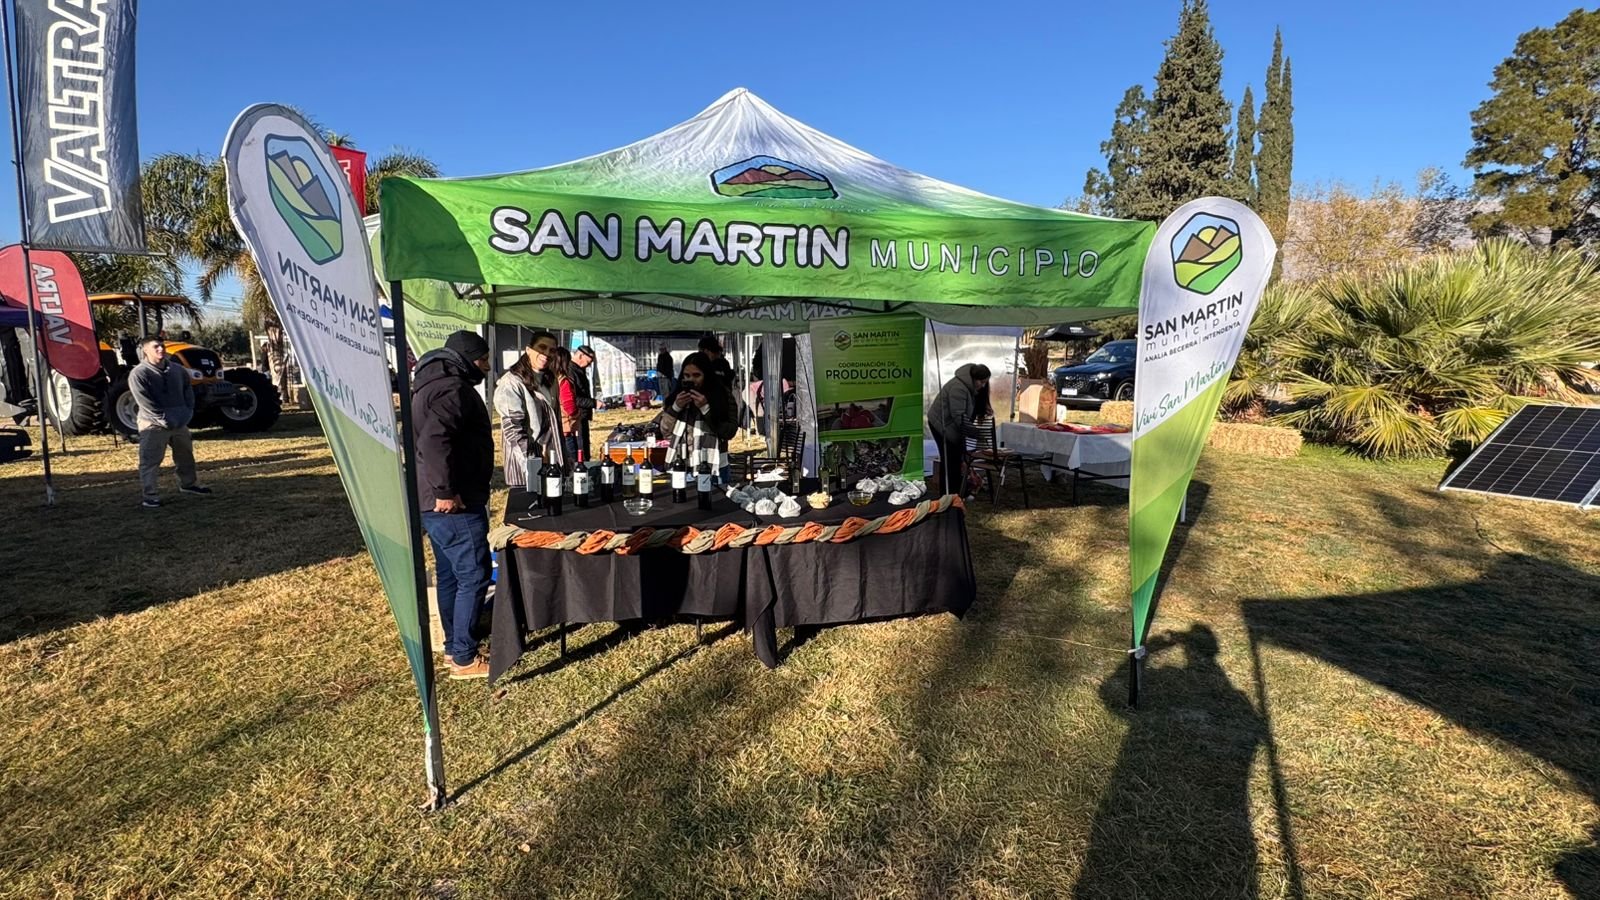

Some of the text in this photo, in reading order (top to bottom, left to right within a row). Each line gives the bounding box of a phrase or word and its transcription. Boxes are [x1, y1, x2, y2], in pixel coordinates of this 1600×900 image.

[488, 206, 851, 270] SAN MARTIN
[869, 238, 1099, 279] MUNICIPIO
[1144, 291, 1243, 340] SAN MARTIN
[1145, 309, 1240, 351] municipio
[1144, 321, 1241, 363] ANALIA BECERRA INTENDENTA
[1160, 393, 1182, 417] San
